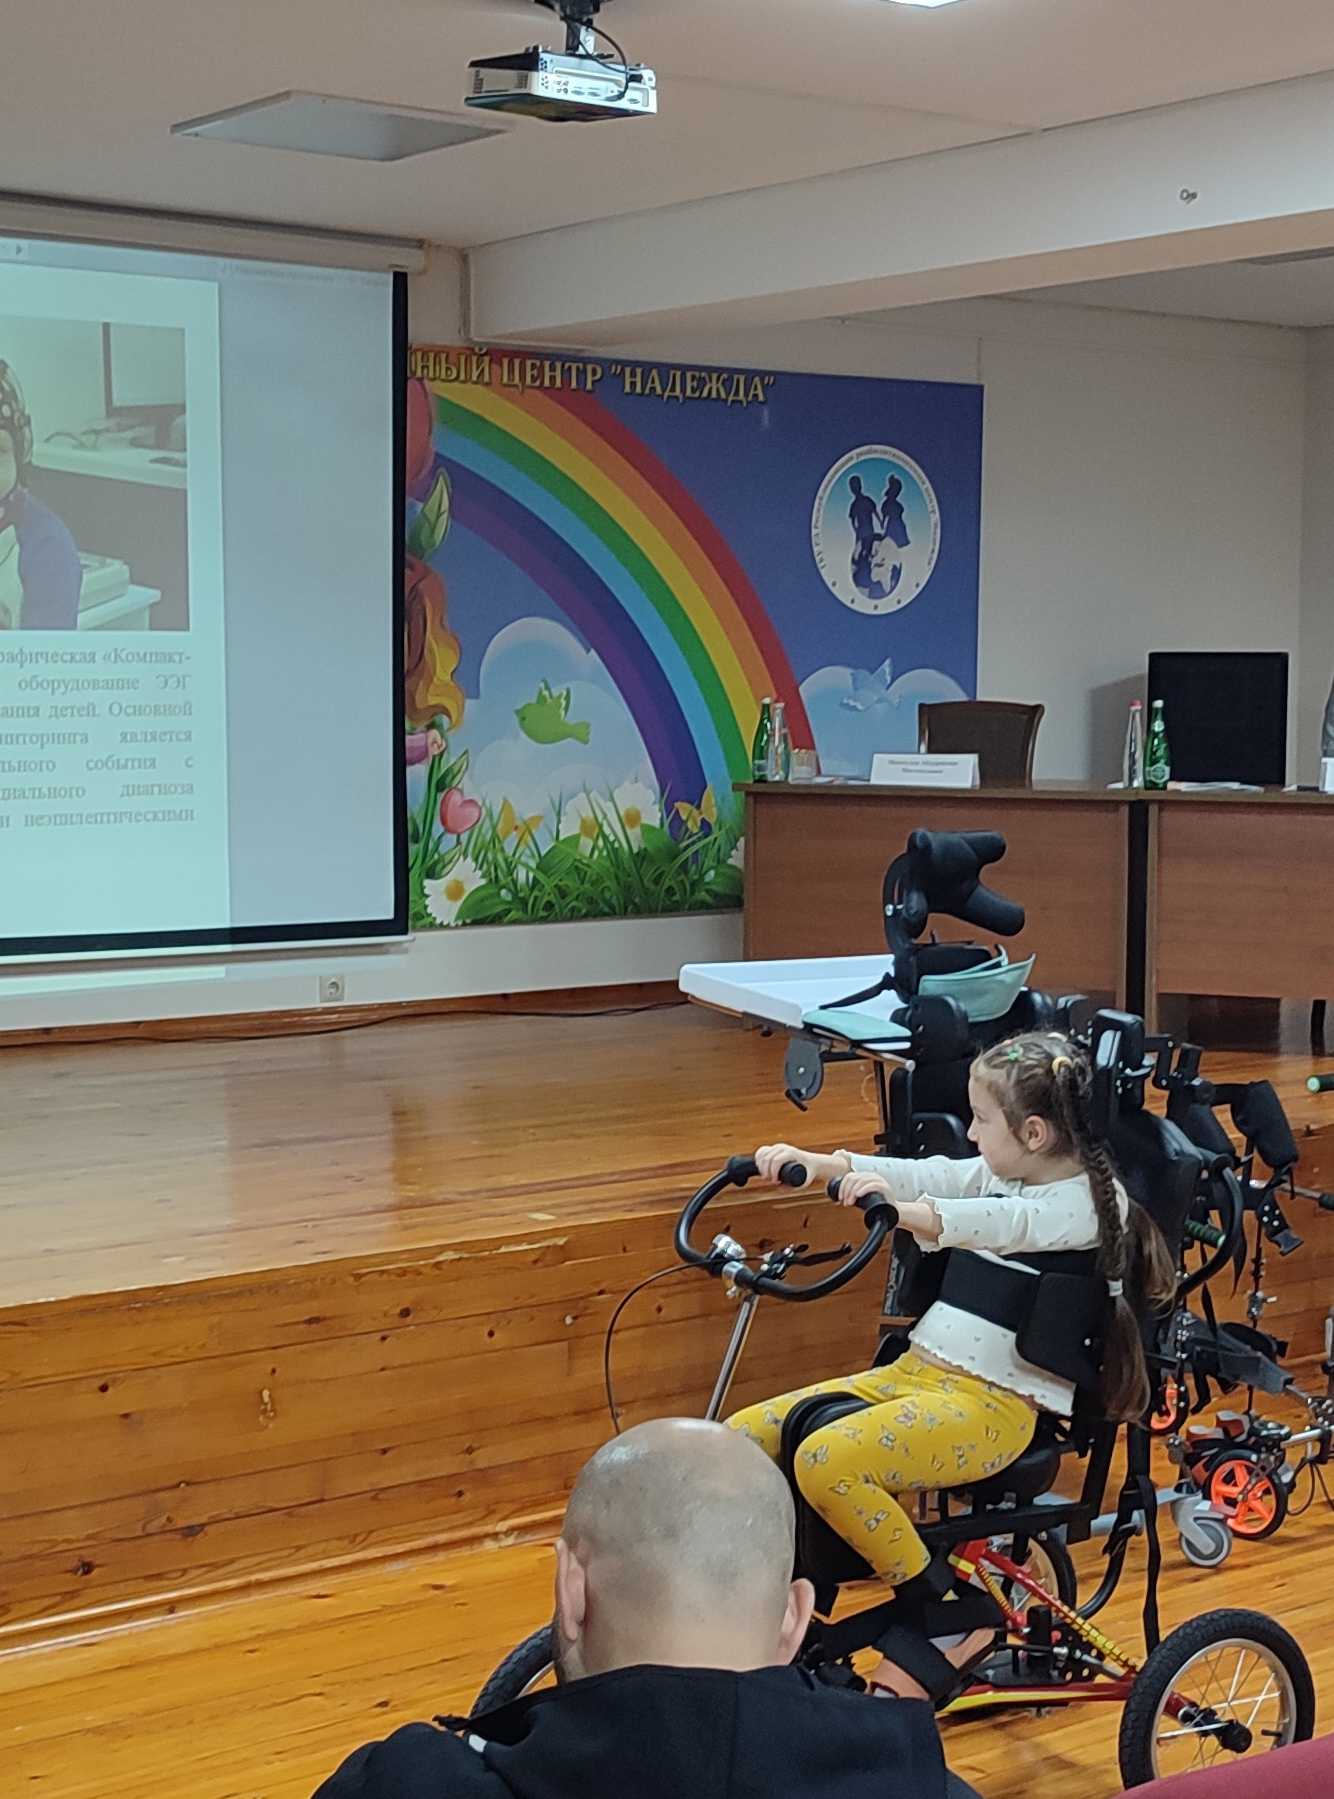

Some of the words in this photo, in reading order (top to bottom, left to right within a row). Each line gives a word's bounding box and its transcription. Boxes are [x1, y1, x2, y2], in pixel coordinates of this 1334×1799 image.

[501, 357, 603, 394] ЦЕНТР
[611, 364, 775, 407] "НАДЕЖДА"
[18, 674, 140, 696] оборудование
[156, 674, 192, 690] ЭЭГ
[48, 701, 101, 719] детей.
[108, 701, 193, 717] Основной
[119, 729, 193, 743] является
[85, 754, 157, 771] события
[185, 756, 194, 768] с
[119, 782, 194, 799] диагноза
[0, 814, 11, 828] и
[23, 808, 195, 828] неэпилептическими
